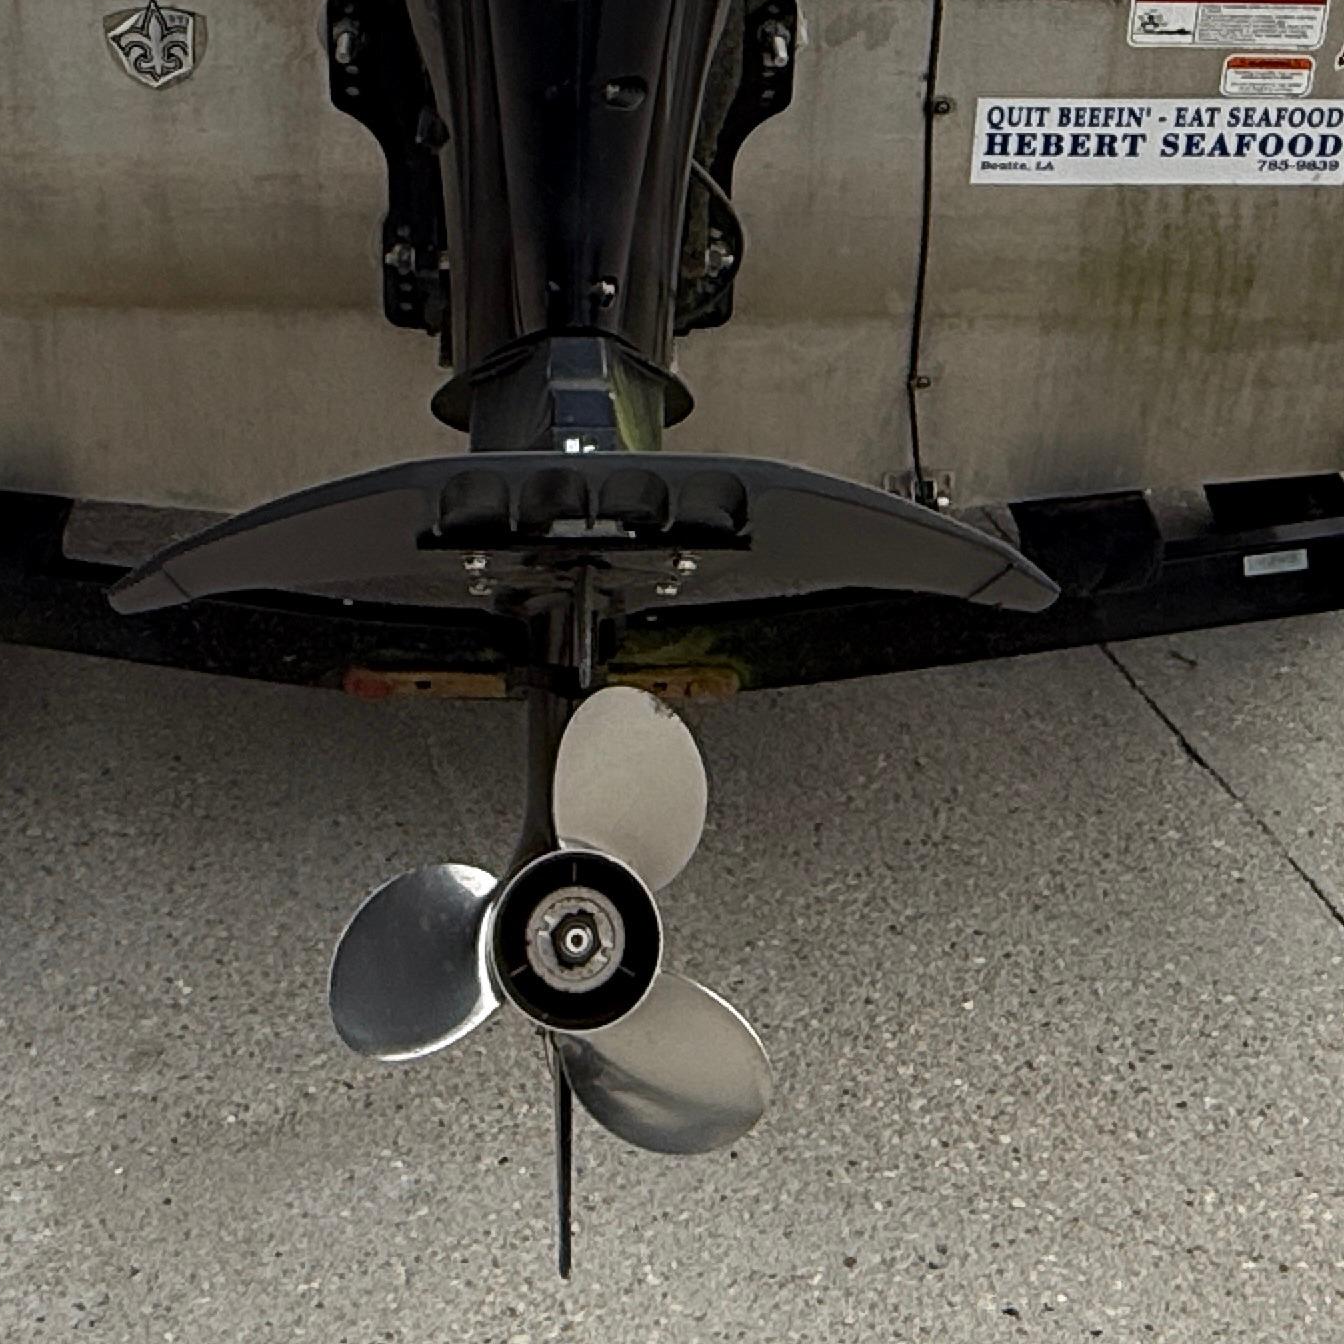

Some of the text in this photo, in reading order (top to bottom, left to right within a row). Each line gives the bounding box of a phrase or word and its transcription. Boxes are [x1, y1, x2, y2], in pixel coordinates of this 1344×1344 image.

[986, 105, 1052, 130] QUIT
[1057, 106, 1152, 128] BEEFIN'
[1174, 106, 1221, 128] EAT
[1226, 106, 1344, 128] SEAFOOD
[983, 131, 1344, 158] HEBERT SEAFOOD
[1035, 160, 1056, 171] LA
